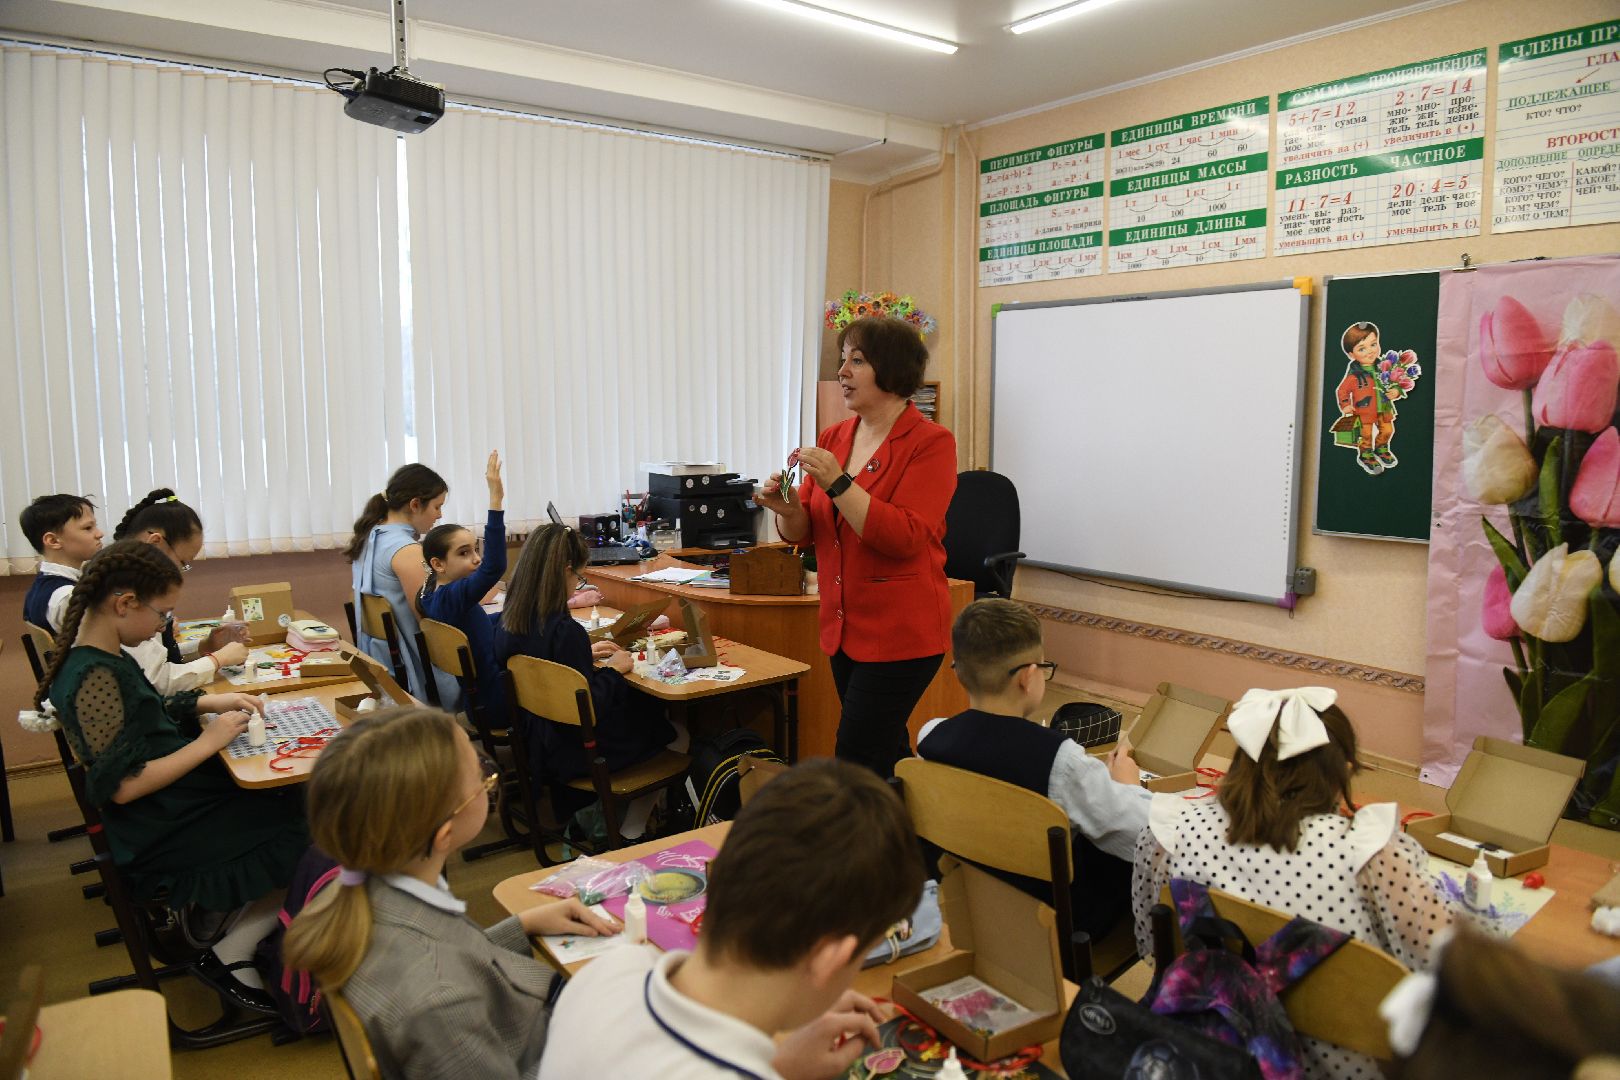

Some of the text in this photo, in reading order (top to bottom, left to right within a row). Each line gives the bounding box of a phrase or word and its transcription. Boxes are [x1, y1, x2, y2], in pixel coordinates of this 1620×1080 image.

[1513, 24, 1620, 57] ЧЛЕНЫ ПР
[1585, 51, 1620, 67] ГЛА
[1555, 104, 1582, 115] ЧТО?
[1122, 102, 1256, 142] ЕДИНИЦЫ ВРЕМЕНИ
[1335, 116, 1367, 128] сумма
[1547, 128, 1620, 148] ВТОРОСТ
[990, 139, 1093, 170] ПЕРИМЕТР ФИГУРЫ
[1391, 145, 1466, 168] ЧАСТНОЕ
[1128, 160, 1247, 192] ЕДИНИЦЫ МАССЫ
[1285, 164, 1358, 185] РАЗНОСТЬ
[990, 187, 1089, 214] ПЛОЩАДЬ ФИГУРЫ
[1126, 216, 1247, 242] ЕДИНИЦЫ ДЛИНЫ
[988, 235, 1093, 259] ЕДИНИЦЫ ПЛОЩАДИ
